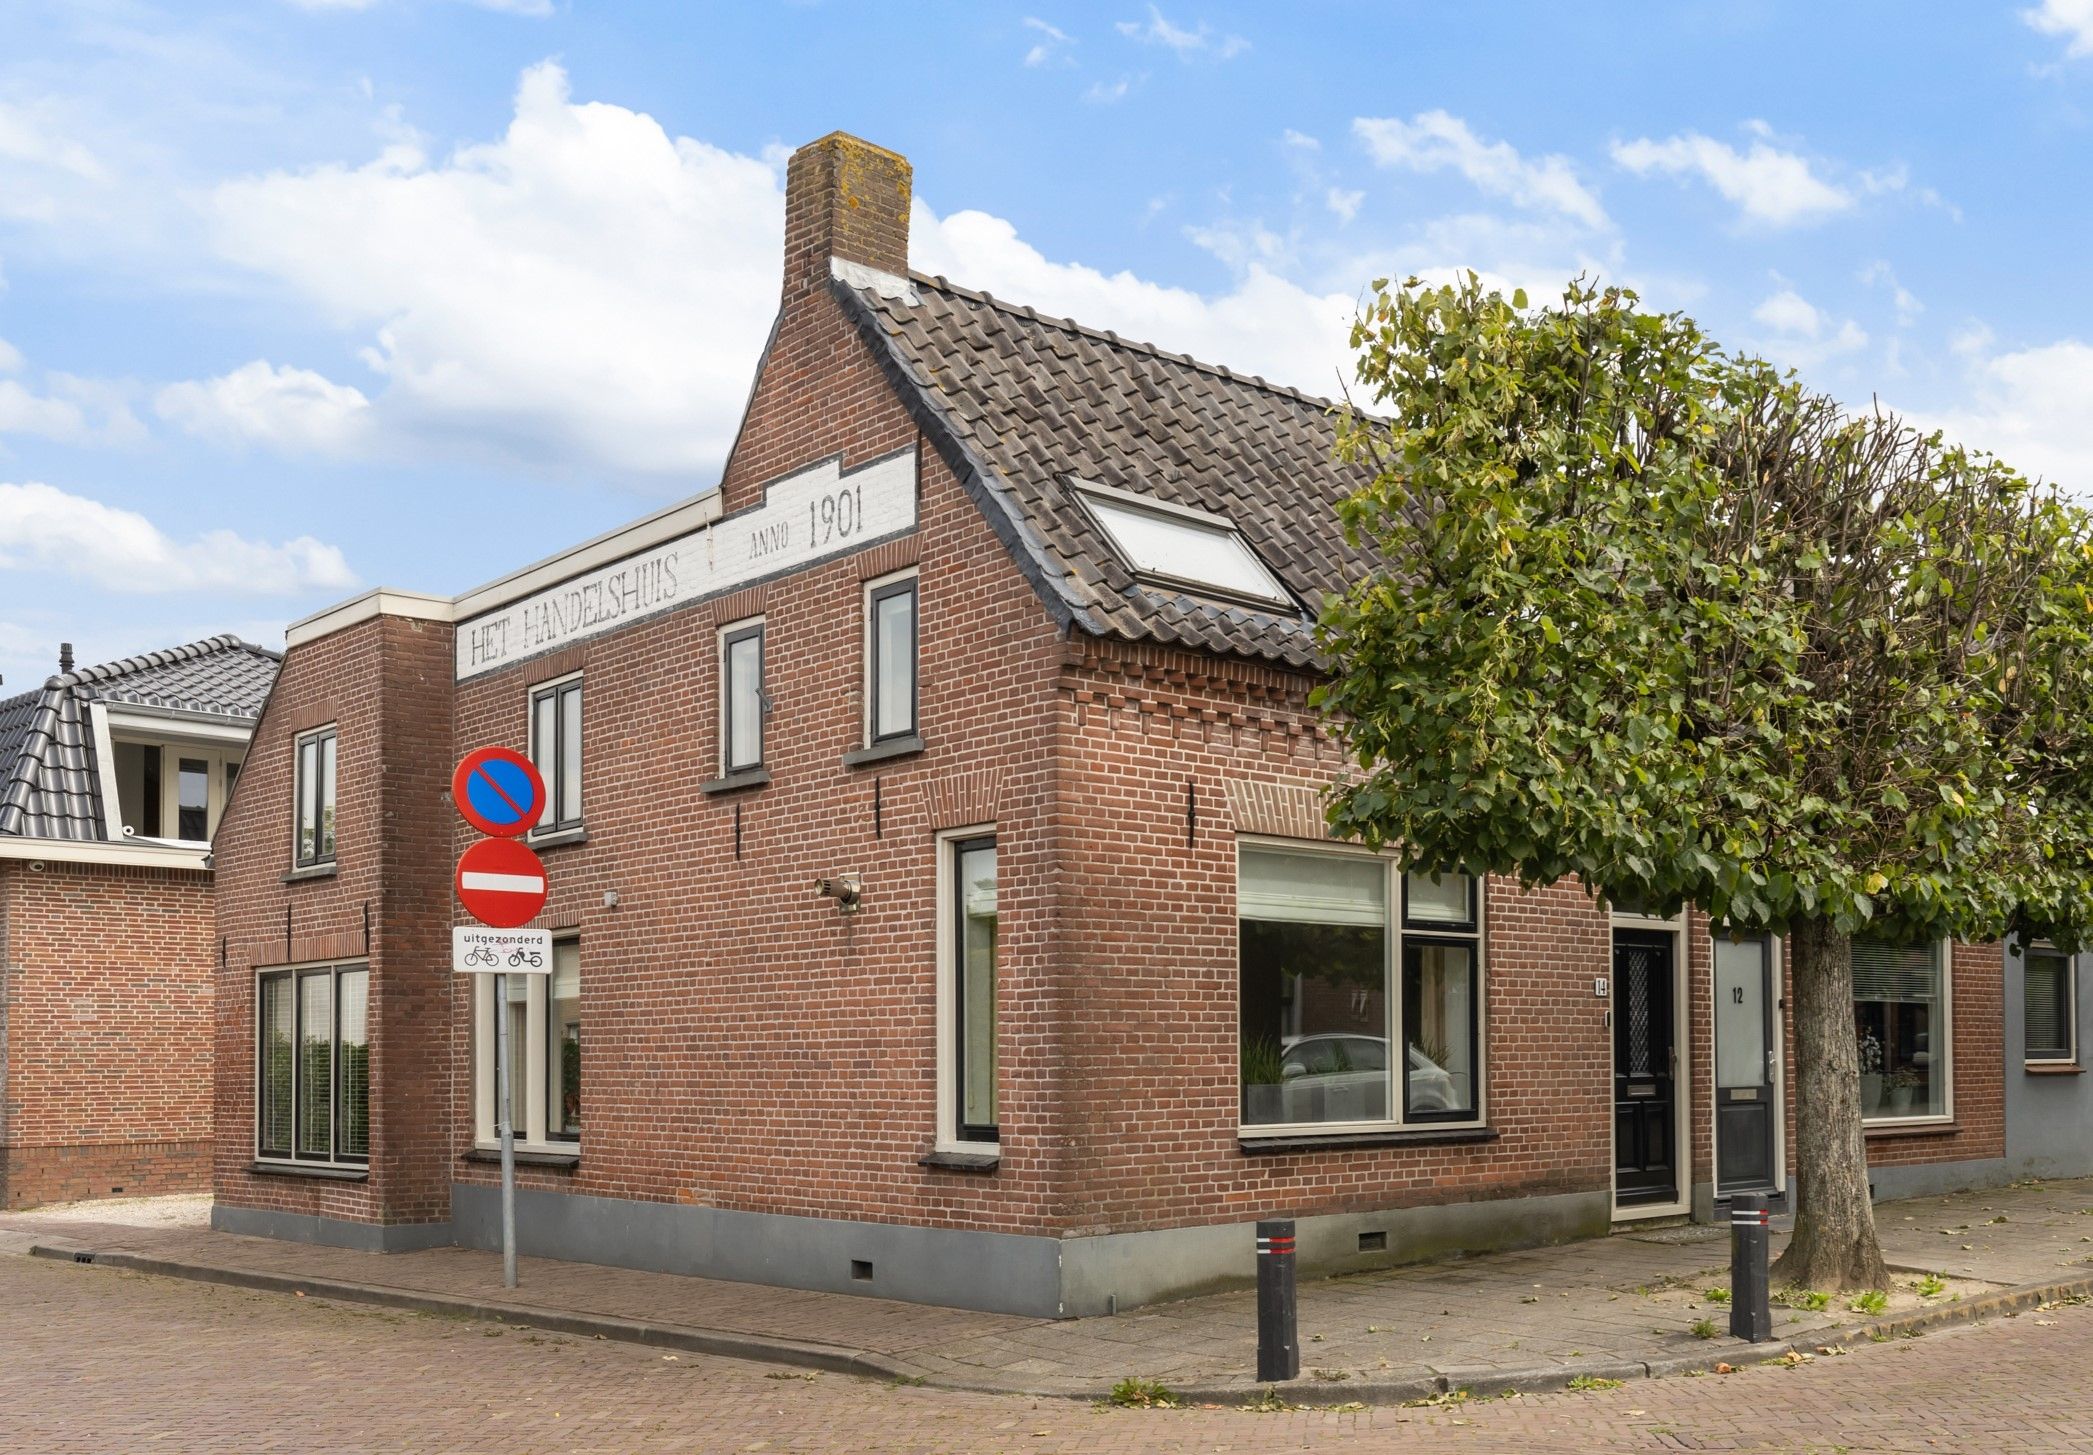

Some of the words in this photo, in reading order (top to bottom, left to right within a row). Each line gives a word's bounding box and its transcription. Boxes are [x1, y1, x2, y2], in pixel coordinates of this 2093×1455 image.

[471, 615, 511, 667] HET
[523, 551, 679, 649] HANDELSHUIS
[749, 520, 789, 560] ANNO
[810, 484, 863, 549] 1901
[463, 933, 543, 946] uitgezonderd
[1597, 979, 1606, 995] 14
[1732, 986, 1744, 1004] 12
